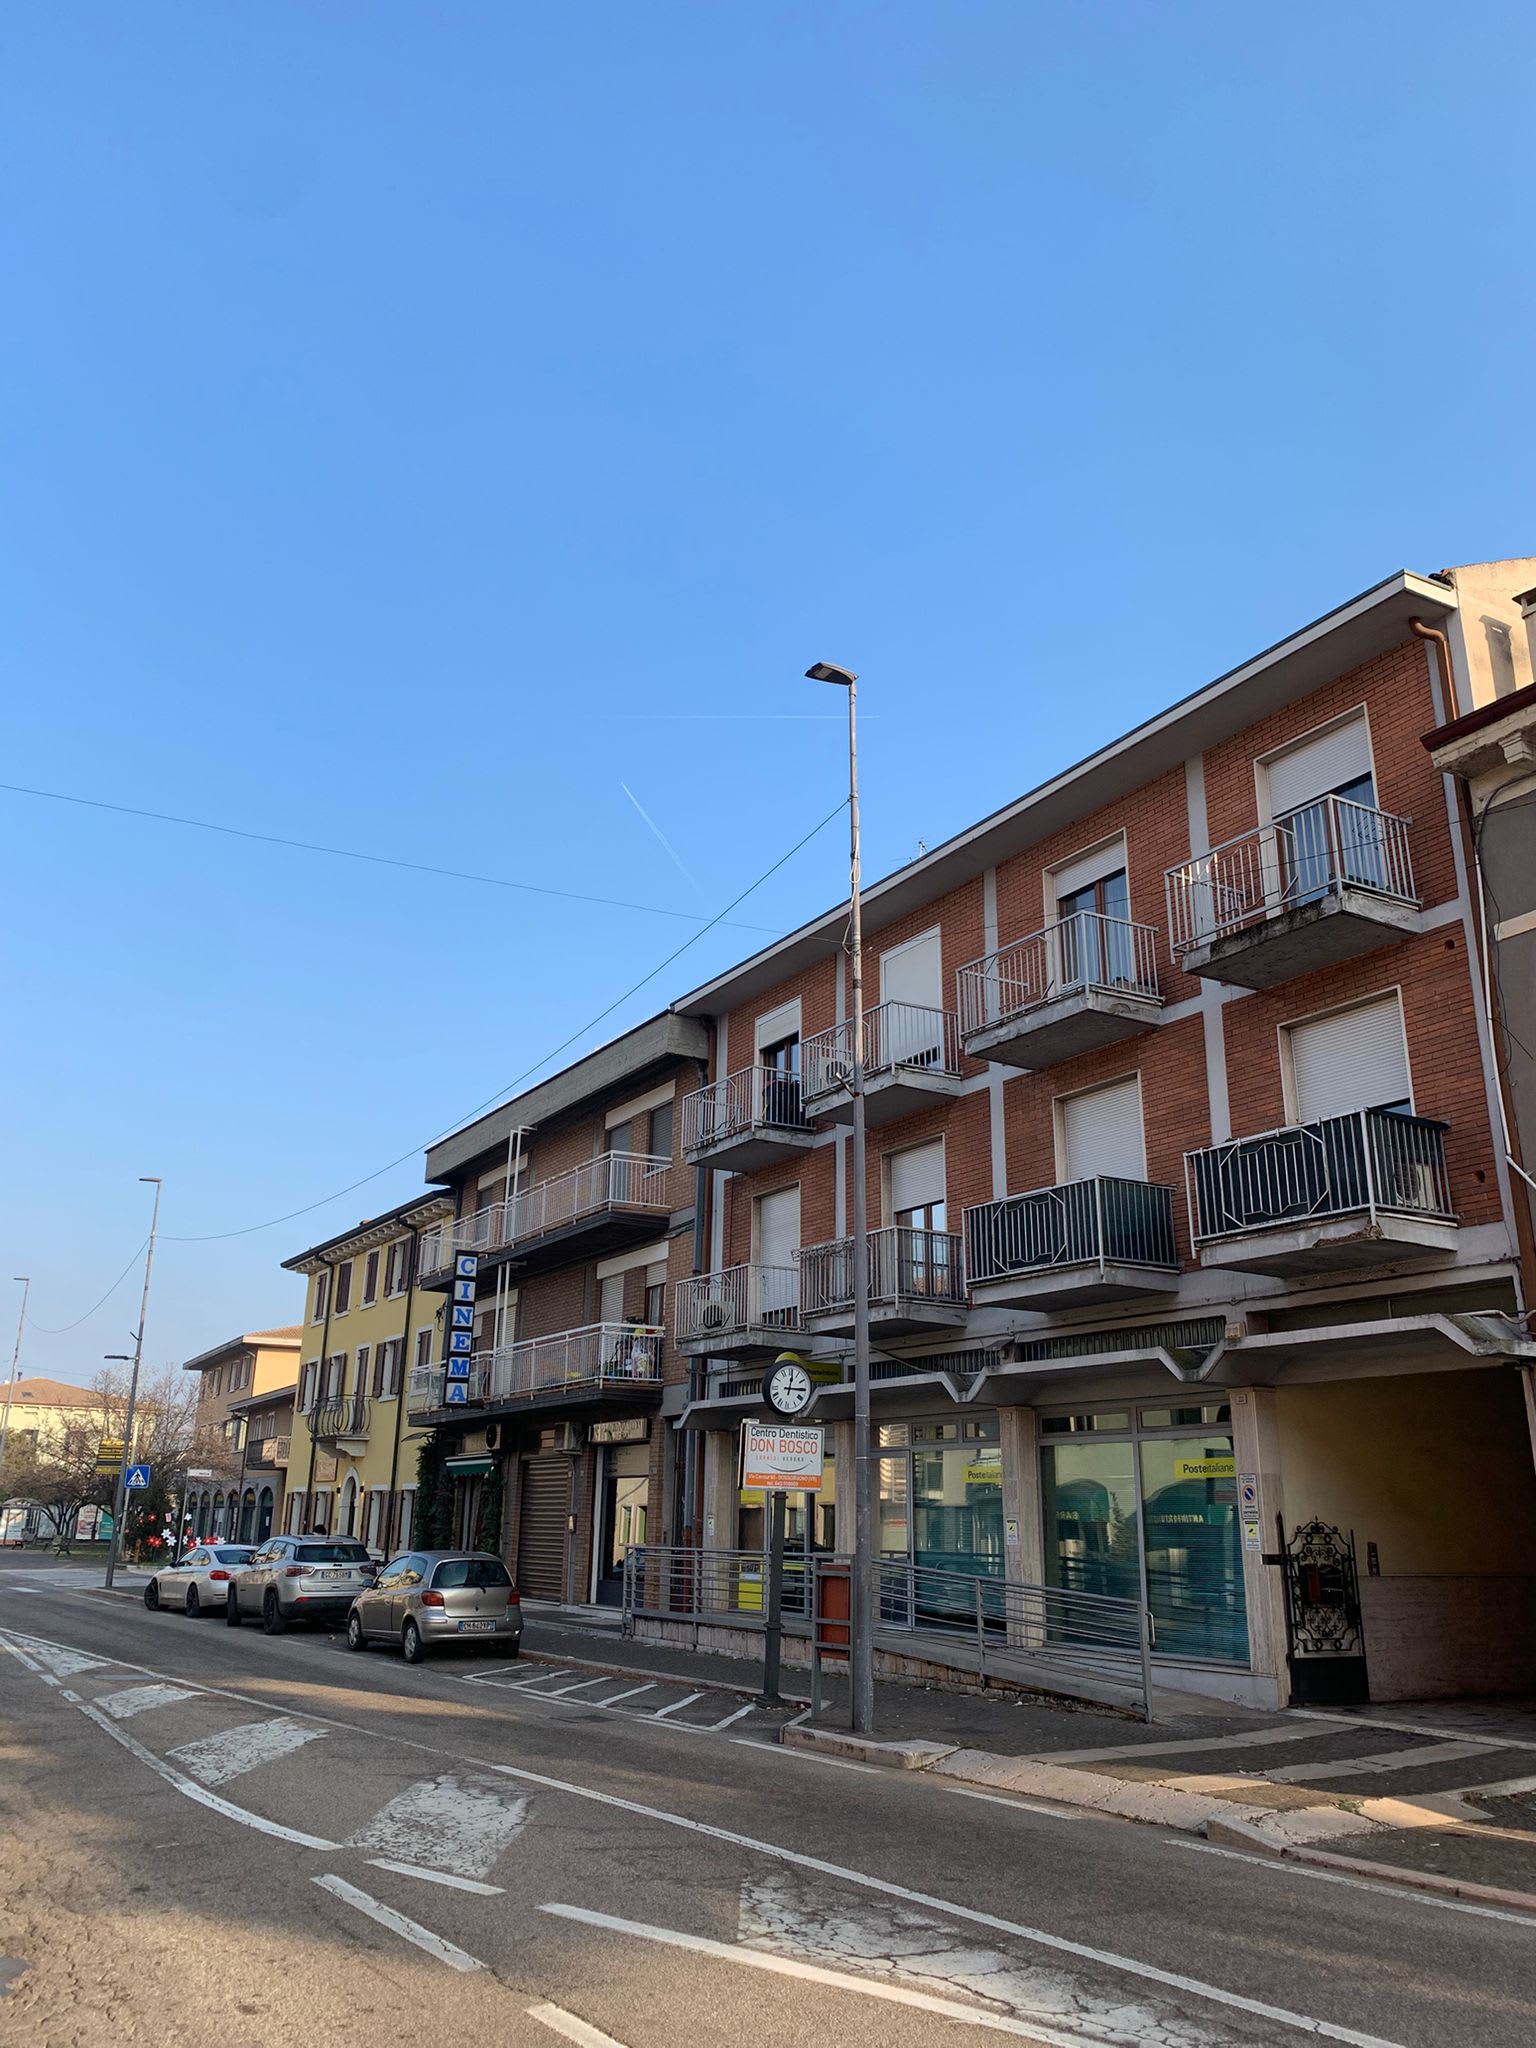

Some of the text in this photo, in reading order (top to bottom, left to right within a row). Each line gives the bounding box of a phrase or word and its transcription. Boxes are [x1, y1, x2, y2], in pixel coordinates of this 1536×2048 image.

[448, 1258, 475, 1403] CINEMA
[750, 1427, 818, 1440] Centro Dentistico
[750, 1438, 818, 1455] DON BOSCO
[1182, 1462, 1235, 1474] Posteitaliane
